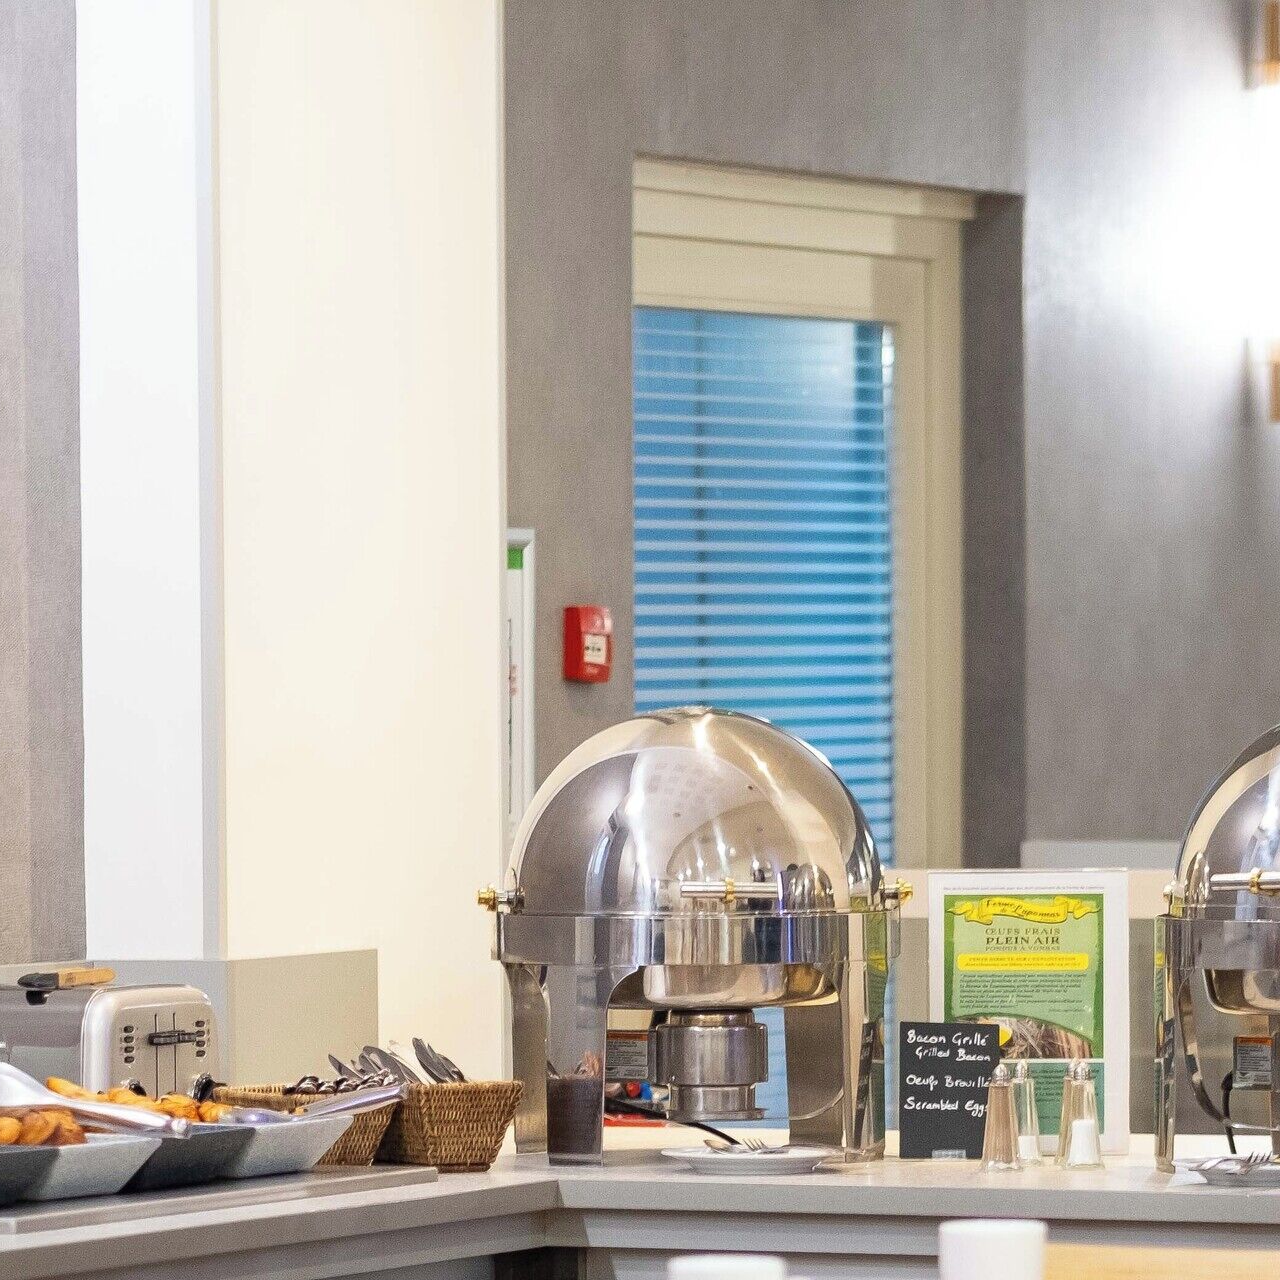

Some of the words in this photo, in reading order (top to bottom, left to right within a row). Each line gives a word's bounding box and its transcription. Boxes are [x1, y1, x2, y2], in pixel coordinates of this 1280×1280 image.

[1025, 927, 1061, 936] FRAIS
[986, 936, 1030, 945] PLEIN
[1033, 936, 1061, 945] AIR
[906, 1029, 947, 1044] Bacon
[951, 1032, 990, 1046] Grillé
[915, 1046, 950, 1060] Grilled
[955, 1047, 991, 1062] Bacon
[903, 1096, 959, 1111] Scrambled
